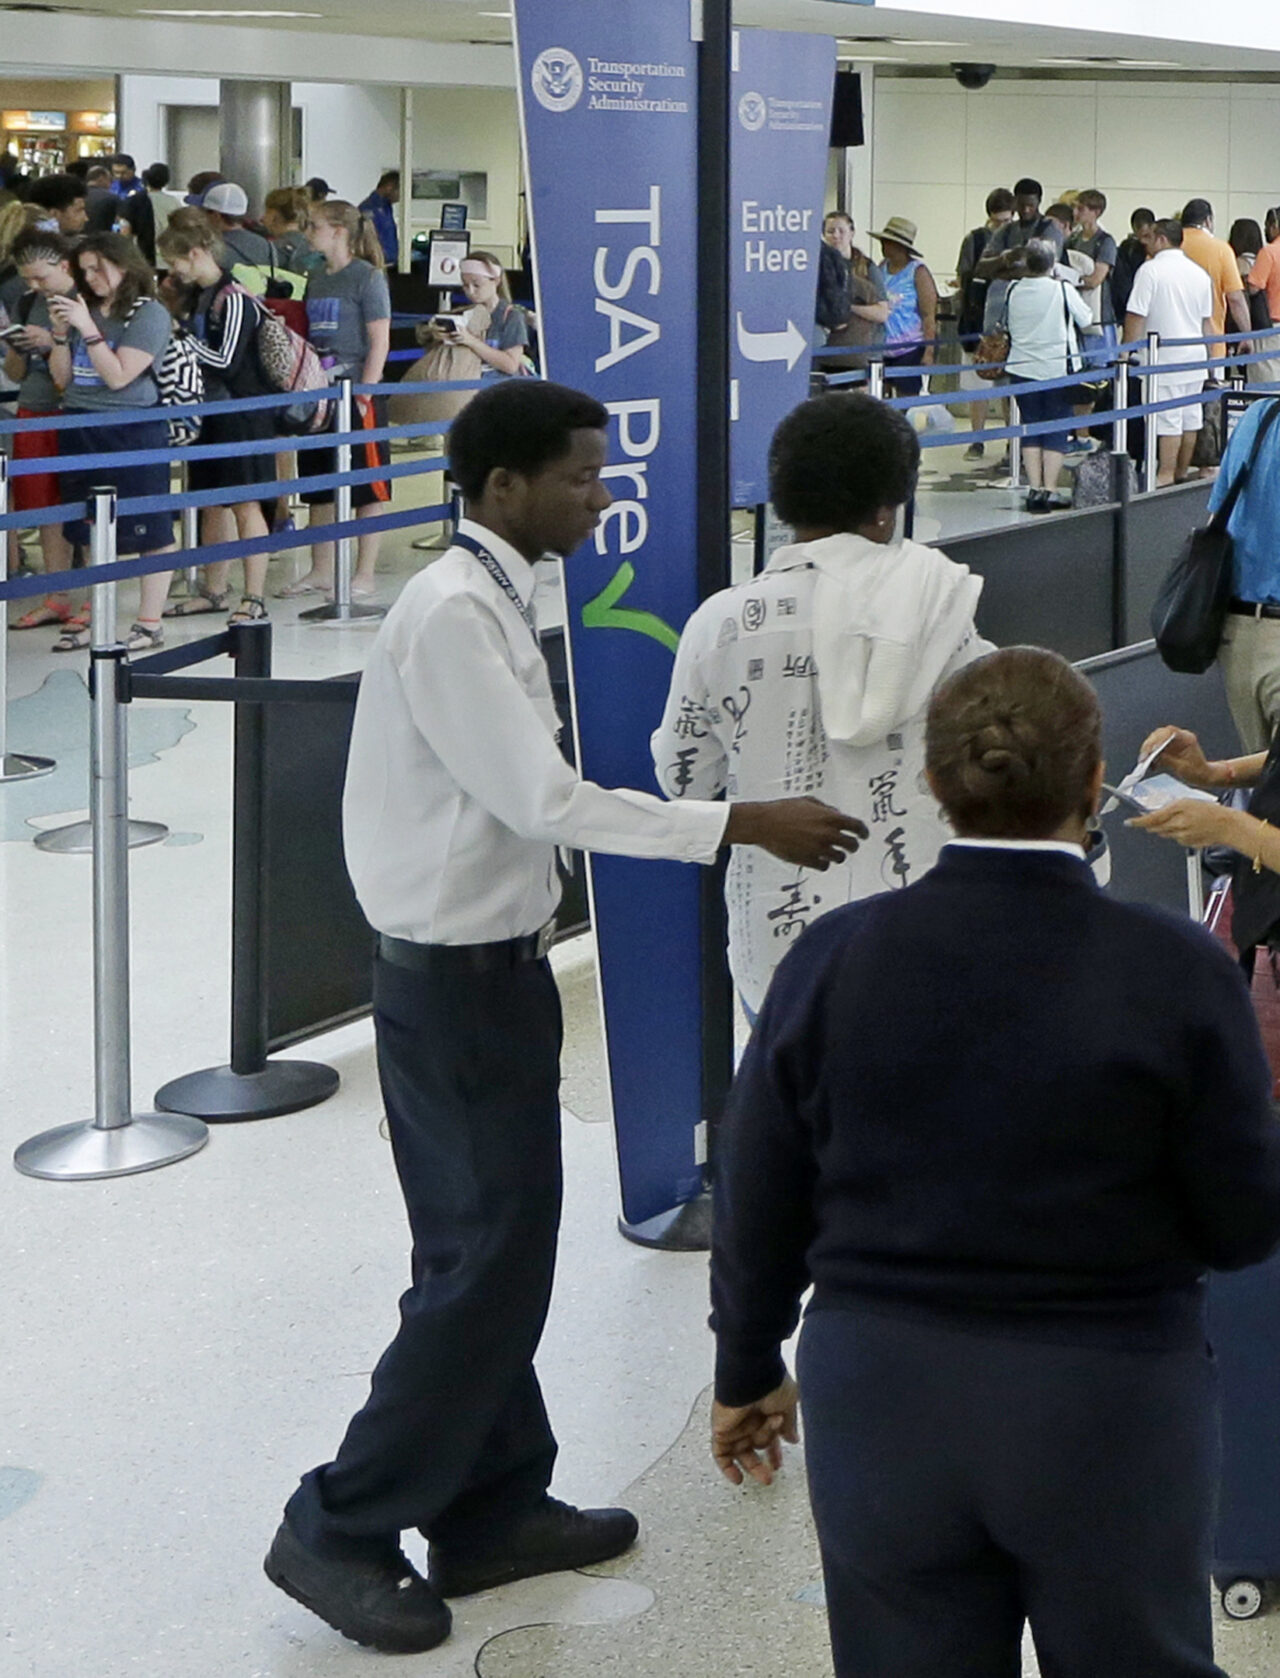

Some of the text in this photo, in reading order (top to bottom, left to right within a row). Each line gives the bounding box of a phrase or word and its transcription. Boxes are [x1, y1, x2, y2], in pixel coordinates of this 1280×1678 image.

[588, 57, 687, 78] Transportation
[588, 77, 645, 96] Security
[588, 94, 689, 113] Administration
[742, 201, 813, 233] Enter
[745, 240, 808, 273] Here
[594, 185, 661, 556] TSA Pre
